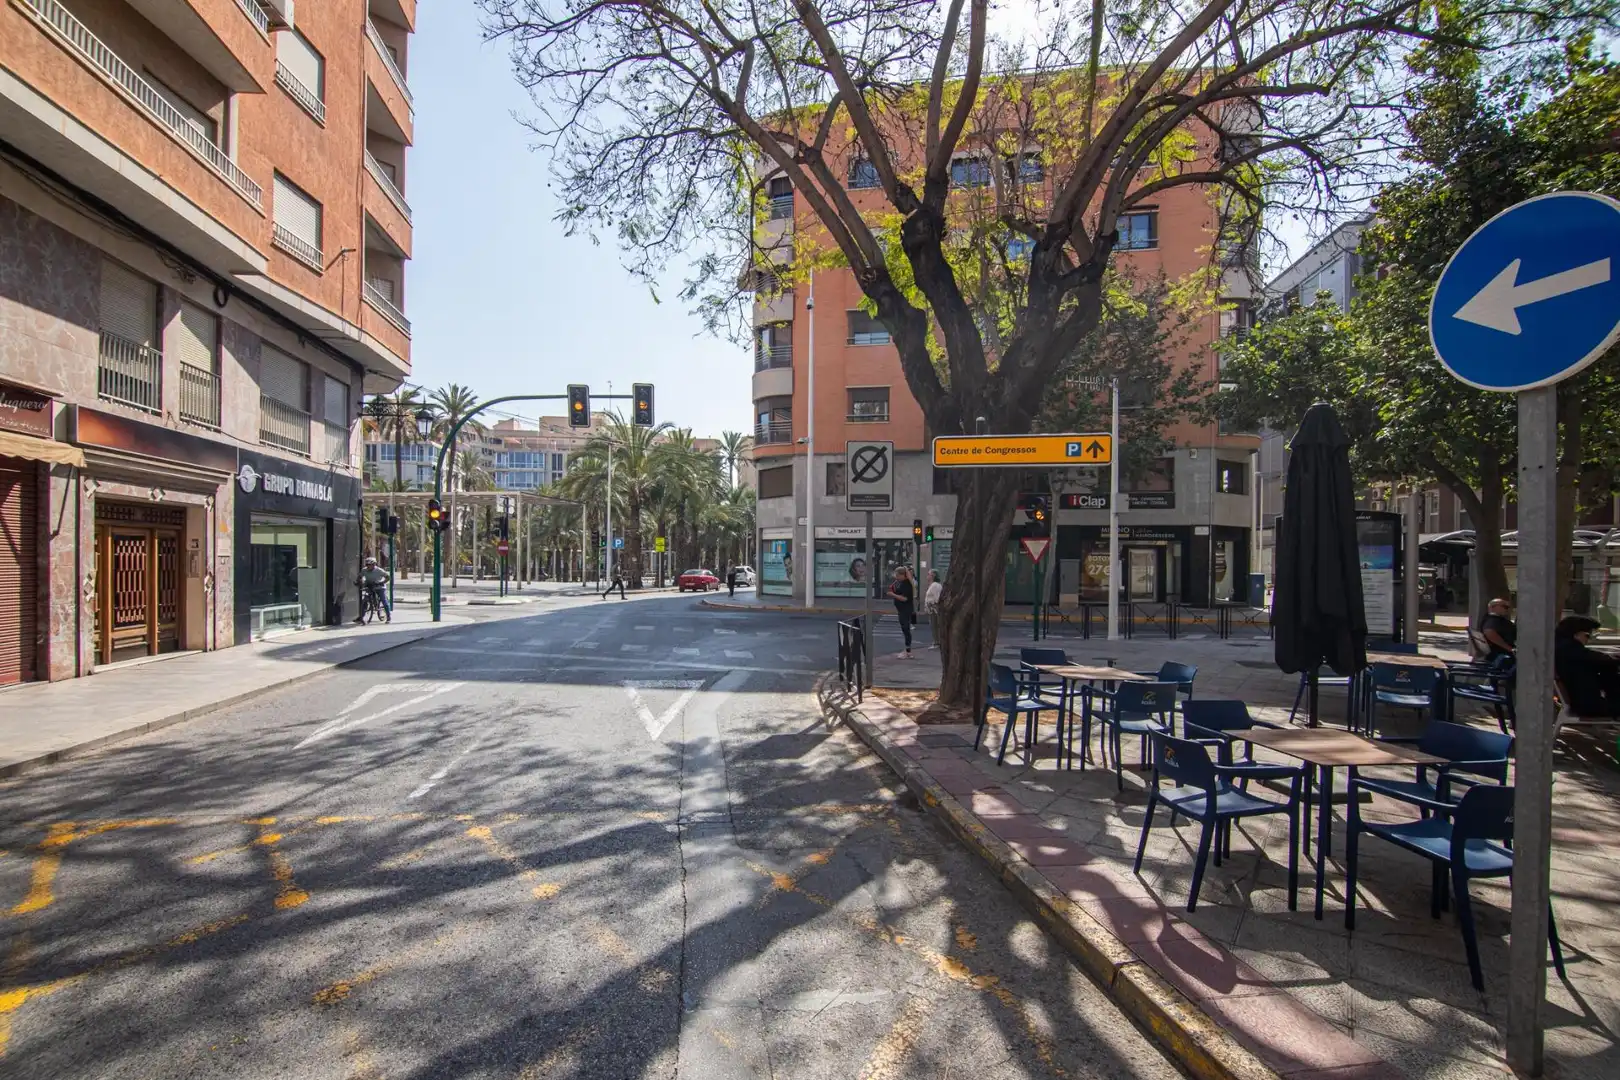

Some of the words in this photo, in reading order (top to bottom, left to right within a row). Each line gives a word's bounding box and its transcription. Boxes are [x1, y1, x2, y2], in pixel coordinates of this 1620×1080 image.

[940, 447, 969, 455] Centre
[985, 446, 1036, 455] Congressos
[1068, 443, 1079, 456] P
[264, 473, 294, 495] GRUPO
[296, 479, 332, 502] ROMABLA
[615, 539, 622, 547] P
